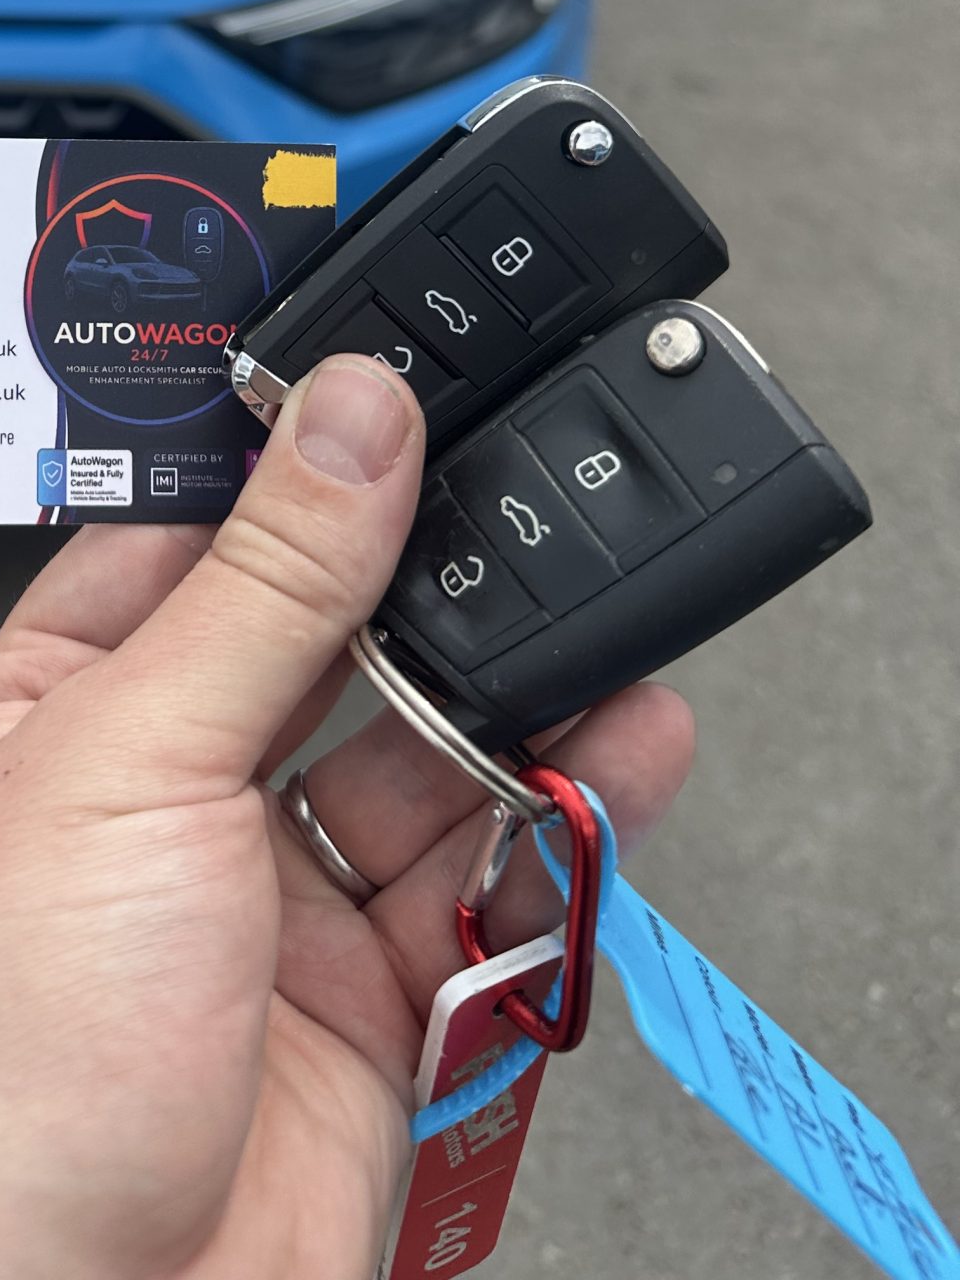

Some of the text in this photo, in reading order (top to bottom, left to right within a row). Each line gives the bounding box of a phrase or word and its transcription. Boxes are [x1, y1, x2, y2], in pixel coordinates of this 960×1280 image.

[130, 349, 169, 361] 24/7
[66, 365, 99, 373] MOBILE
[128, 366, 178, 374] LOCKSMITH
[180, 366, 196, 374] CAR
[89, 377, 206, 385] ENHANCEMENT SPECIALIST
[70, 456, 123, 467] AutoWagon
[153, 453, 223, 463] CERTIFIED BY
[70, 469, 98, 477] Insured
[106, 469, 124, 479] Fully
[70, 479, 103, 487] Certified
[155, 475, 173, 487] IMI
[424, 1201, 478, 1271] 140
